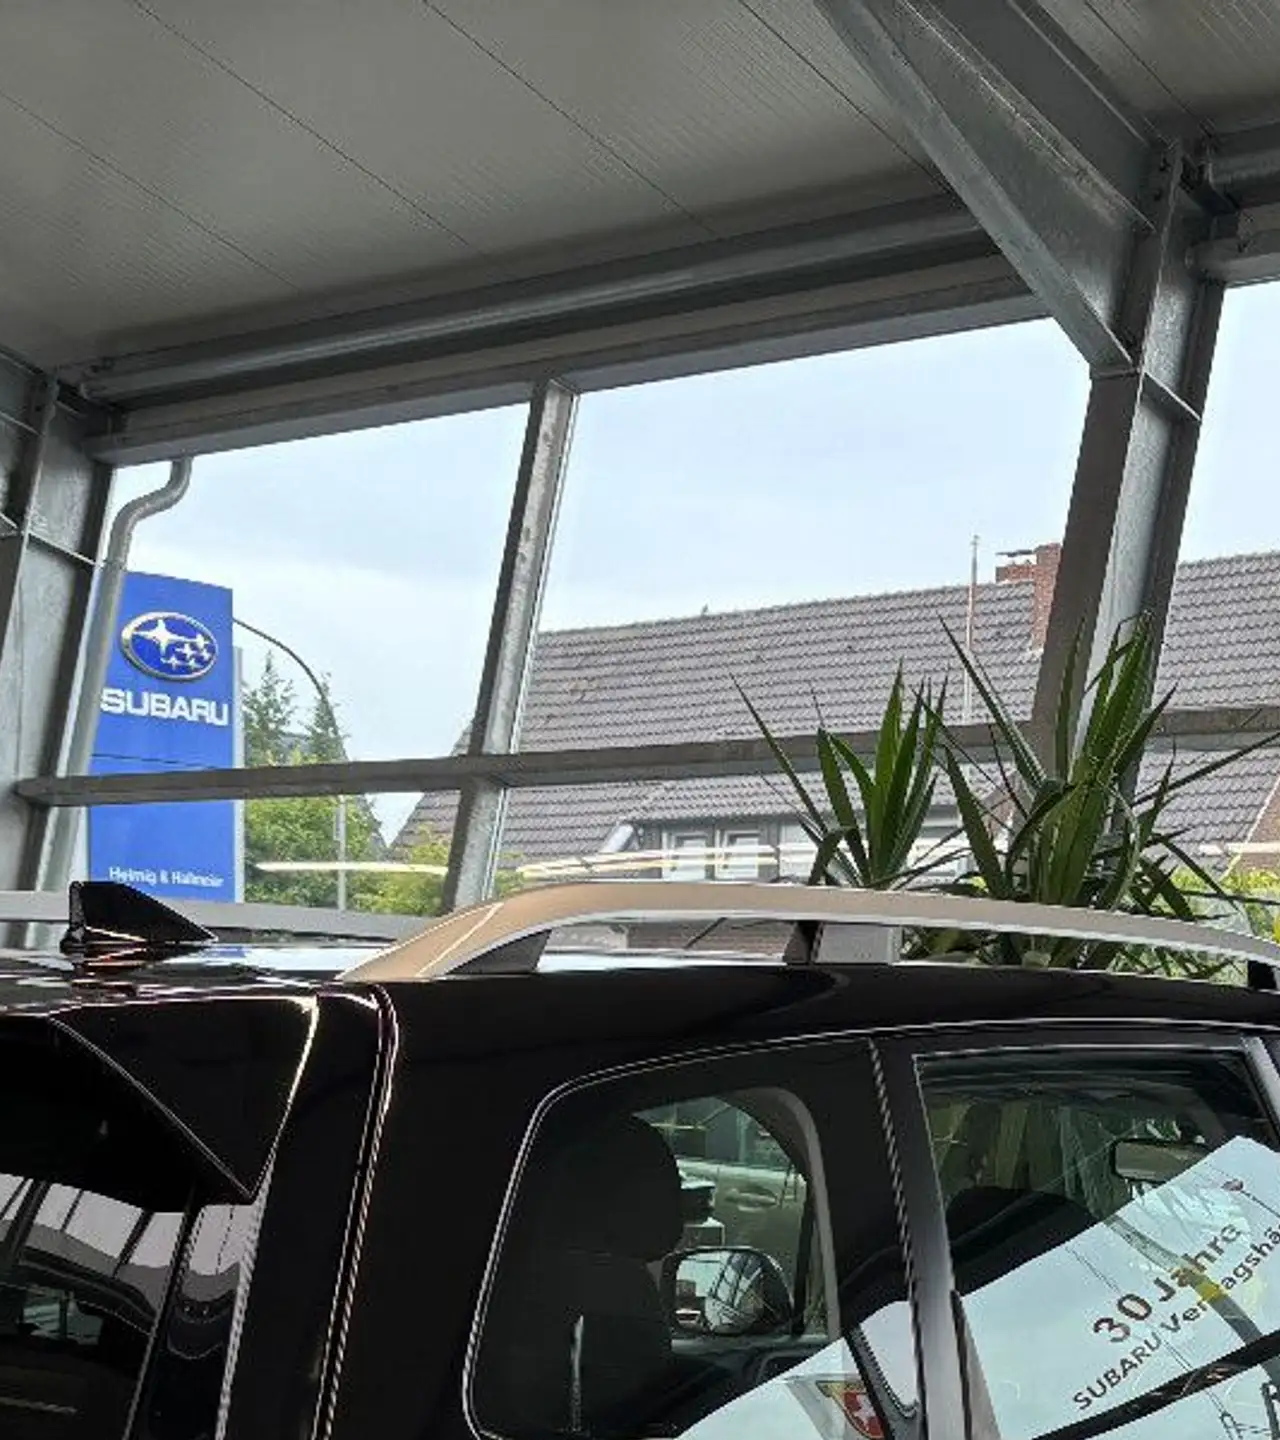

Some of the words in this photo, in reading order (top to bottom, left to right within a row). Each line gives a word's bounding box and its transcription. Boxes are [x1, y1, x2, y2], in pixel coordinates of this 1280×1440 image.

[101, 689, 229, 726] SUBARU
[1093, 1291, 1153, 1343] 30
[1156, 1223, 1243, 1304] Jahre
[1072, 1330, 1162, 1411] SUBARU
